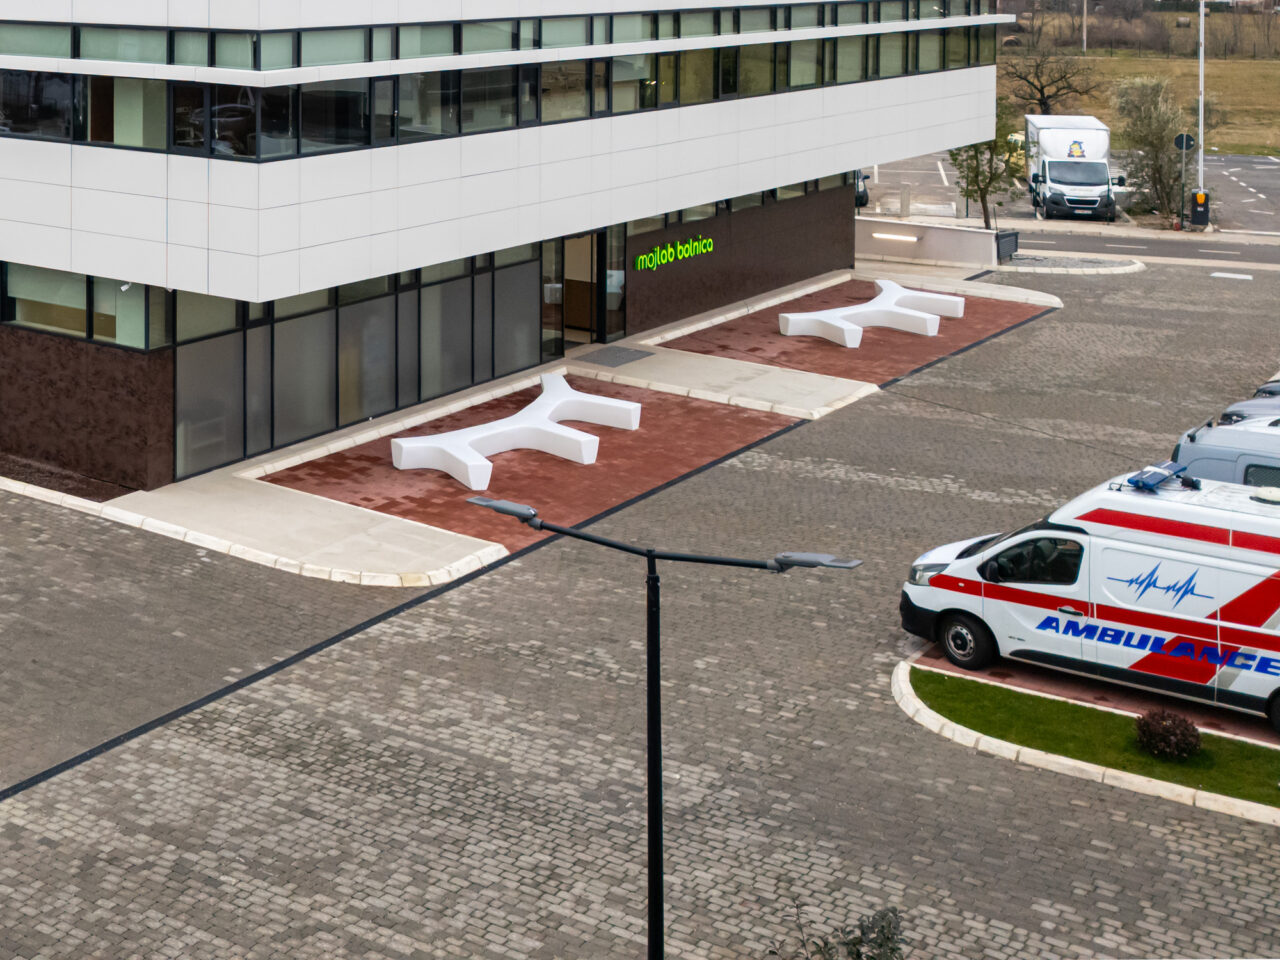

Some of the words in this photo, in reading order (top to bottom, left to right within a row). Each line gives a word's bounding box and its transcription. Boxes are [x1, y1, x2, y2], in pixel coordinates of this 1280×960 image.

[635, 243, 675, 271] mojlab
[675, 234, 714, 260] bolnica
[1035, 615, 1280, 677] AMBULANCE
